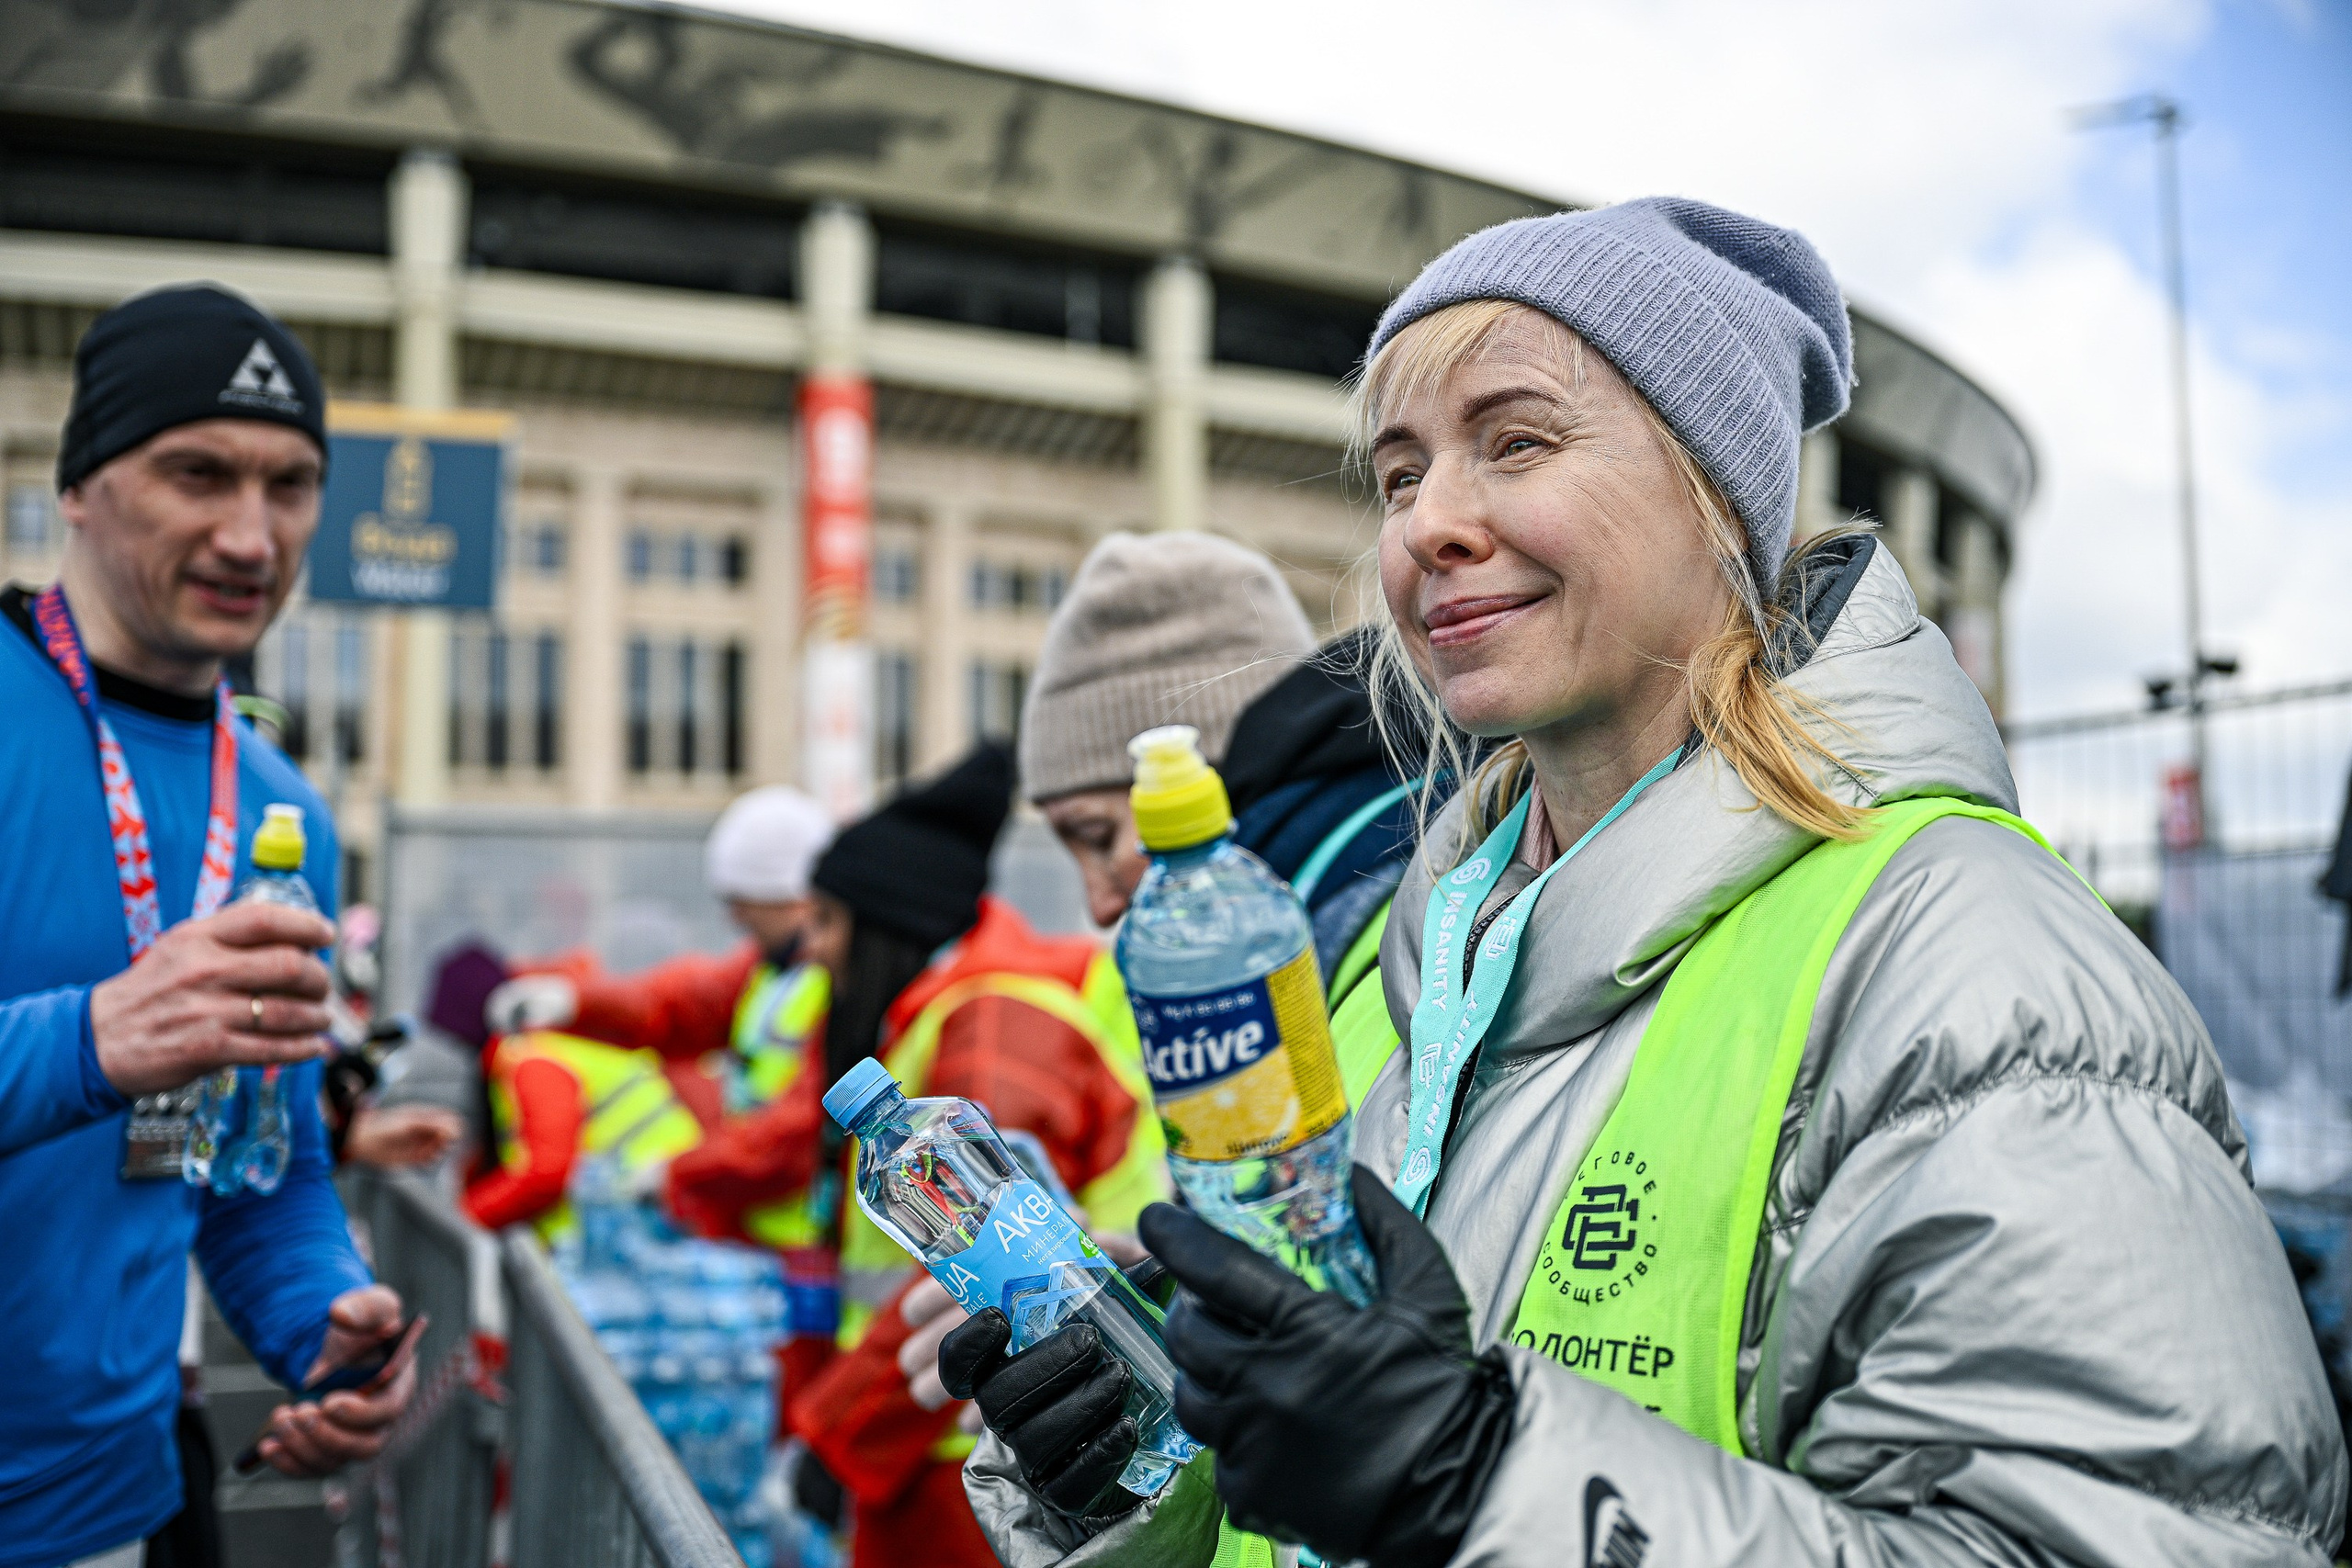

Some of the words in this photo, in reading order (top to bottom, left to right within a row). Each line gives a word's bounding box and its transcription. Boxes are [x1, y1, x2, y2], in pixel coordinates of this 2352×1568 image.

[1431, 891, 1468, 1011] INSANITY
[1423, 989, 1477, 1137] INSANITY
[1511, 1329, 1675, 1378] ОЛОНТЁР
